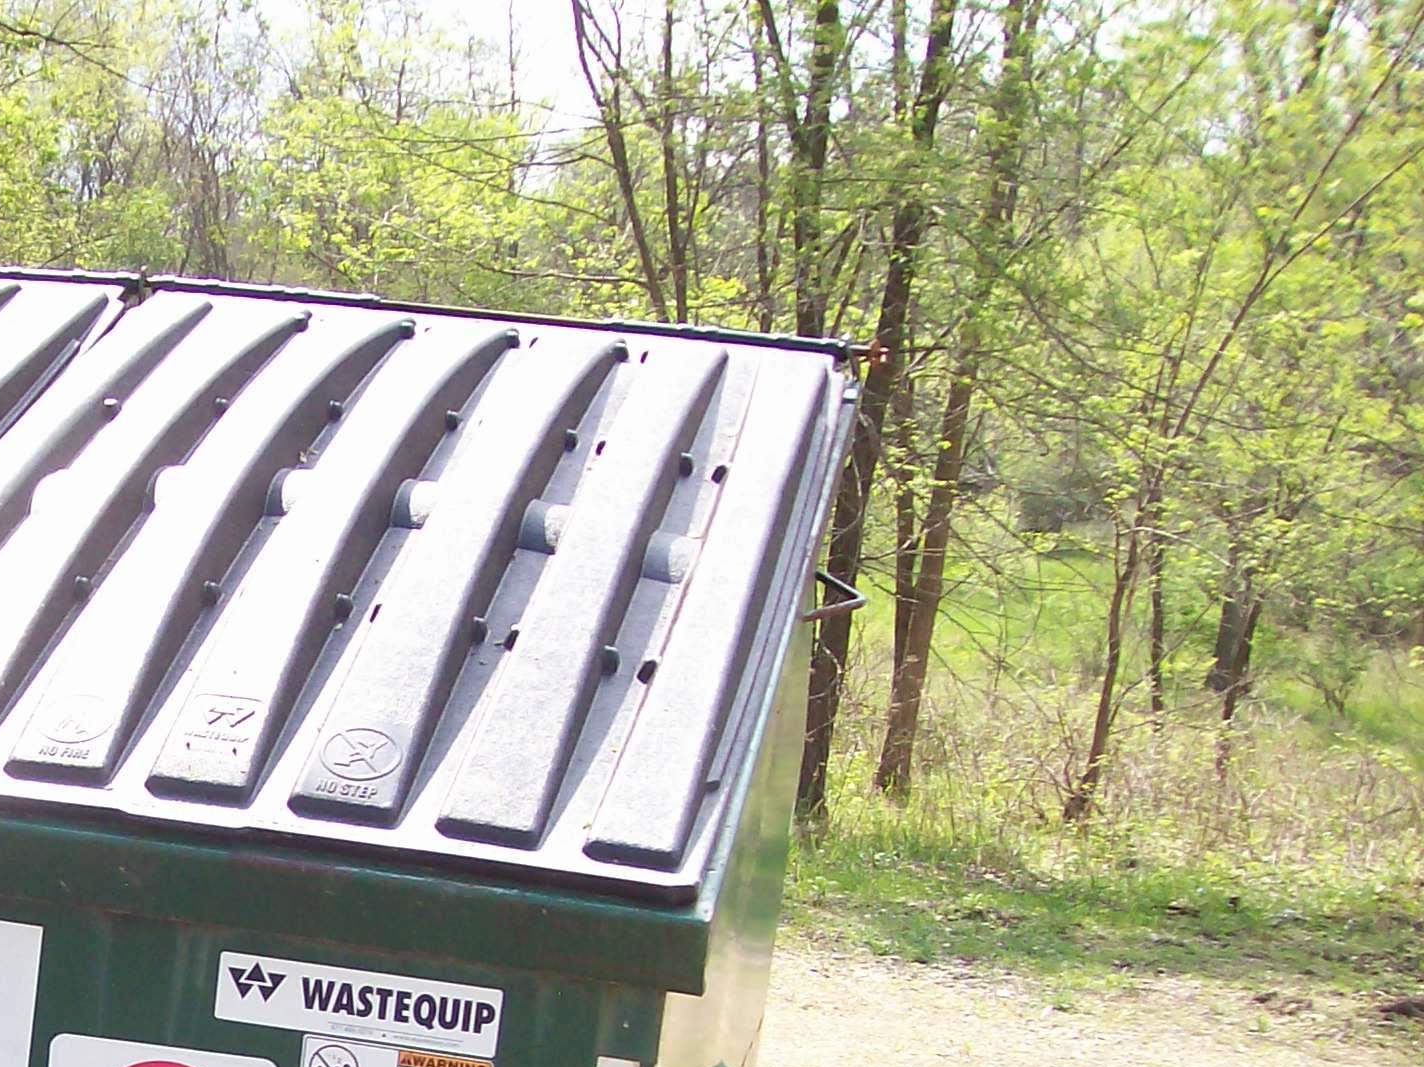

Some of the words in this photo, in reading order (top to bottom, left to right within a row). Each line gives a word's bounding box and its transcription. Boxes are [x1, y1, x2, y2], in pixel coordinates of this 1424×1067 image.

[316, 780, 337, 794] NO
[340, 784, 378, 799] STEP
[301, 976, 496, 1034] WASTEQUIP
